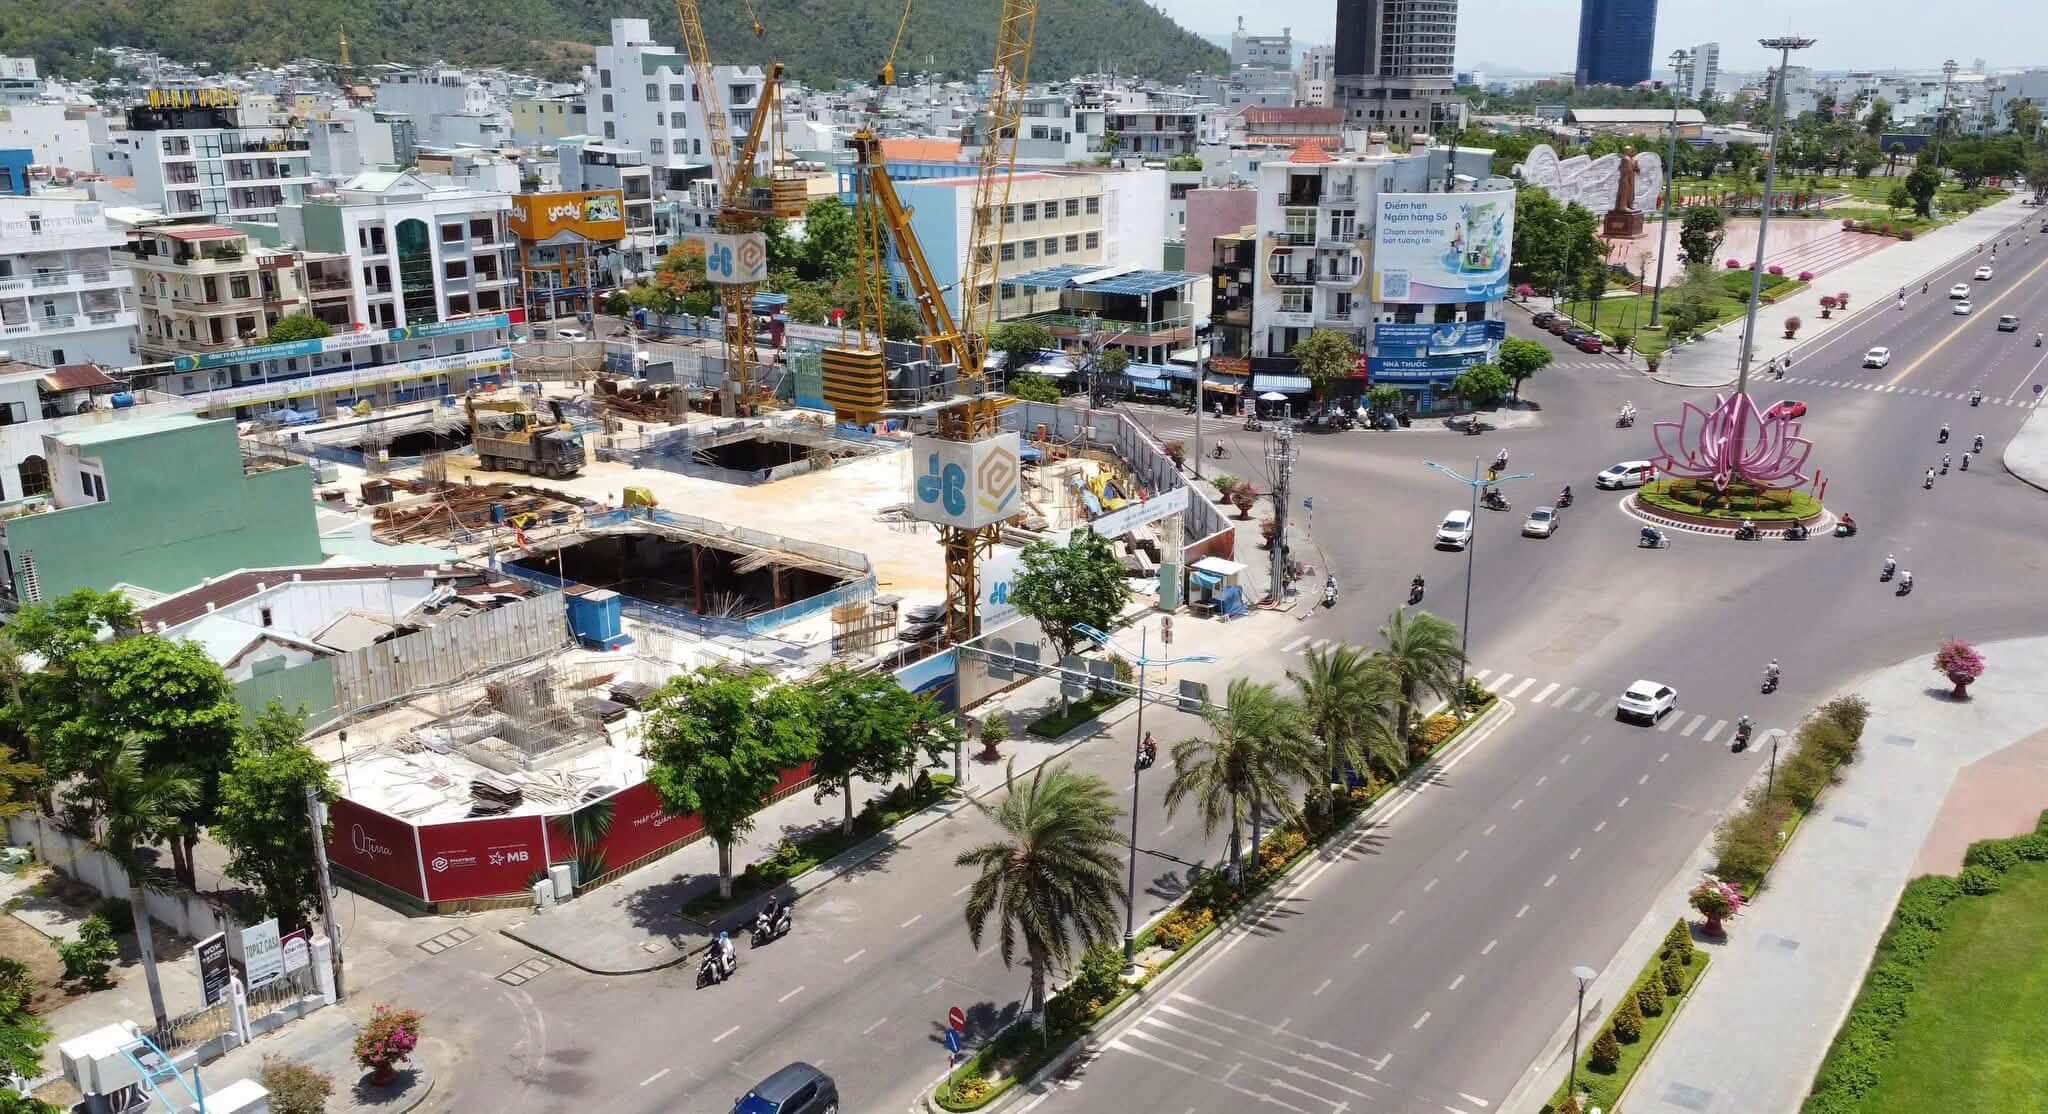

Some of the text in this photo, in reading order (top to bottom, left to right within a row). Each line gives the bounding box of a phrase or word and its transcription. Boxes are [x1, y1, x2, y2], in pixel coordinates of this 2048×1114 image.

[548, 200, 581, 222] yody
[507, 851, 529, 863] MB
[245, 941, 264, 959] TOPAZ
